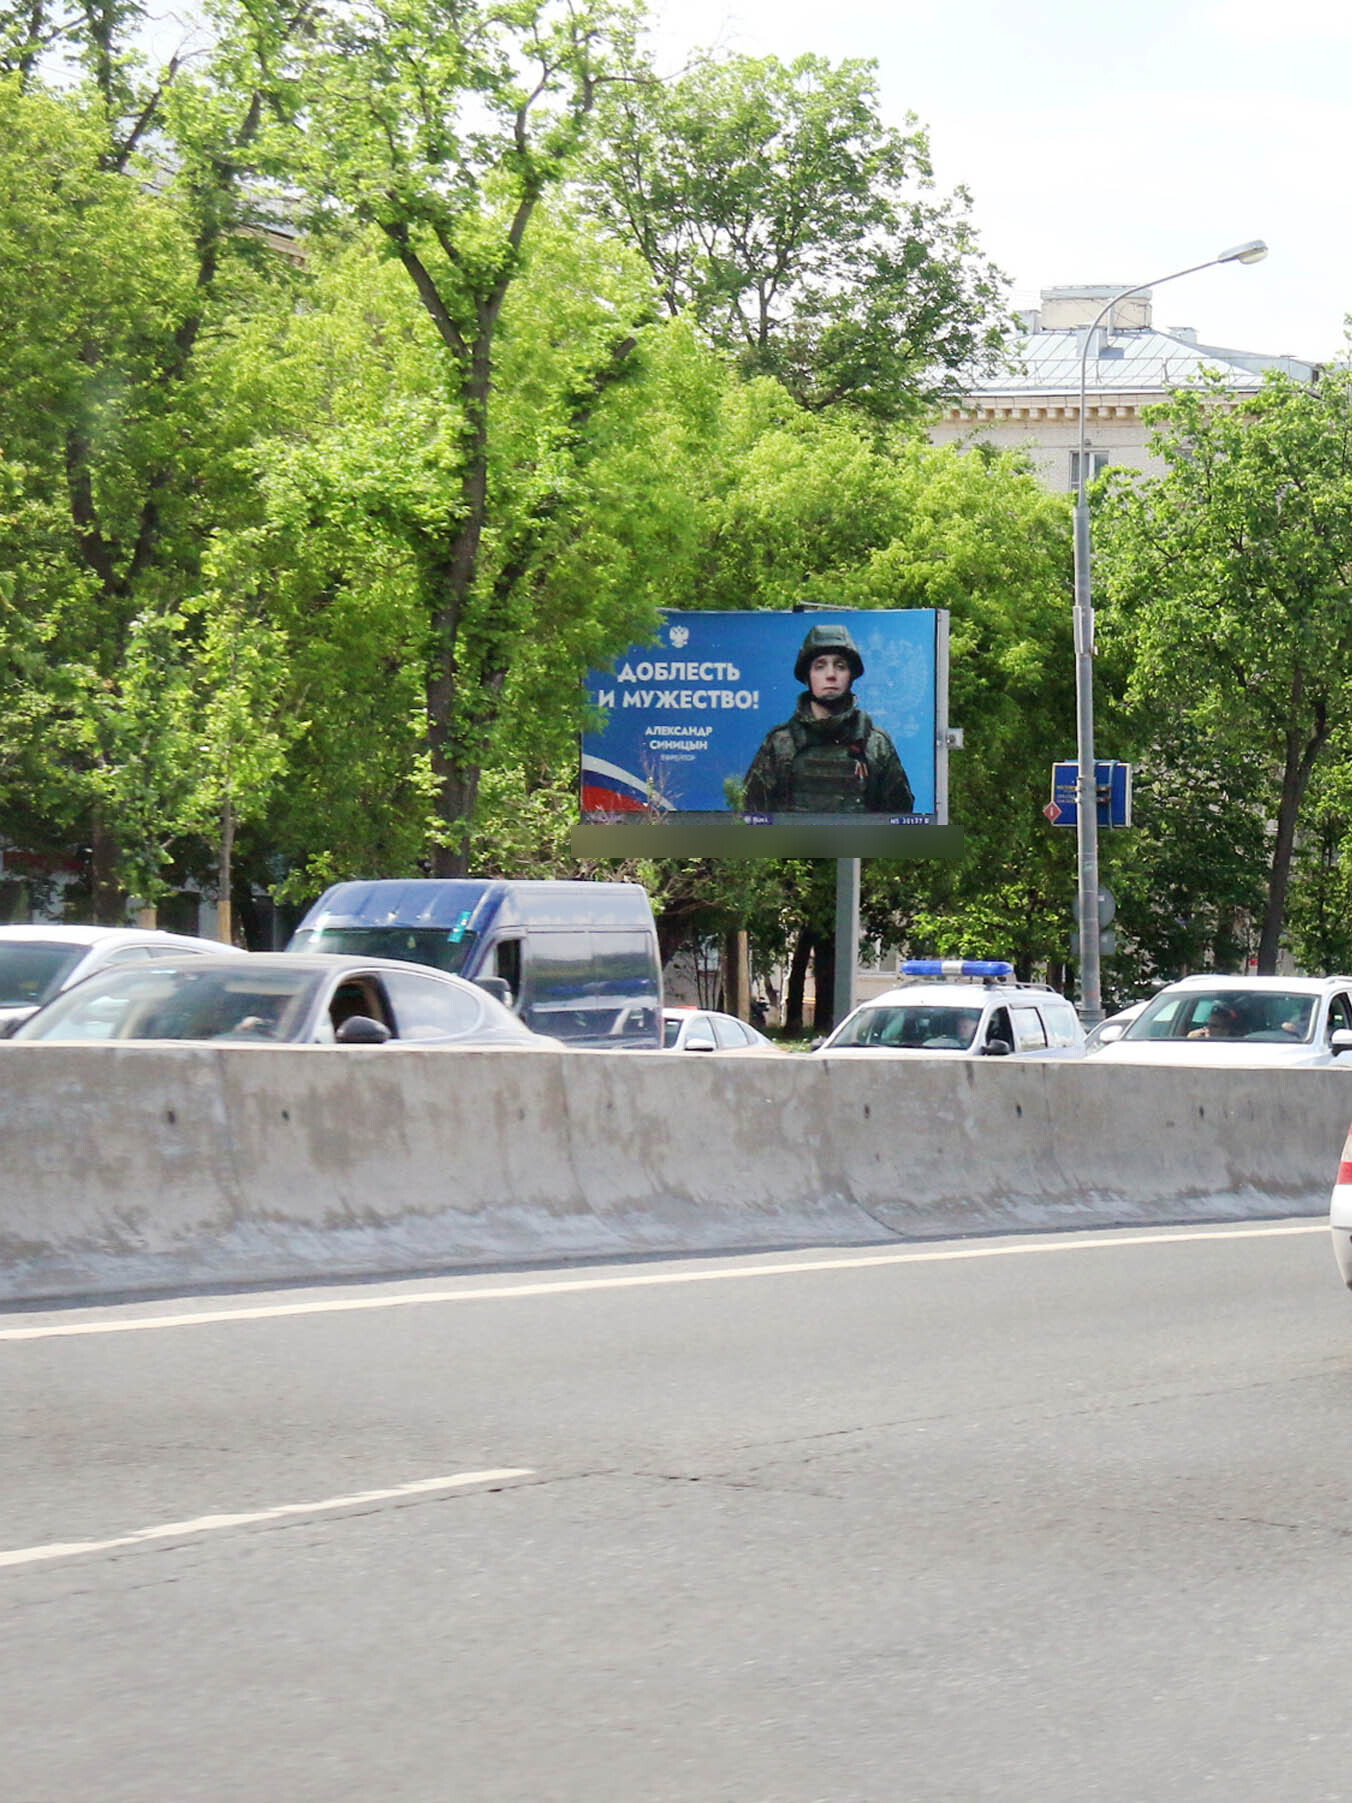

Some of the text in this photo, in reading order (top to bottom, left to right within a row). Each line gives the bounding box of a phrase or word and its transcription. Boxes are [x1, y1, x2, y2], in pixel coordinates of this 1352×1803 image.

[617, 661, 741, 683] ДОБЛЕСТЬ
[598, 689, 760, 710] И МУЖЕСТВО!
[645, 726, 713, 737] АЛЕКСАНДР
[649, 740, 708, 751] СИНИЦЫН
